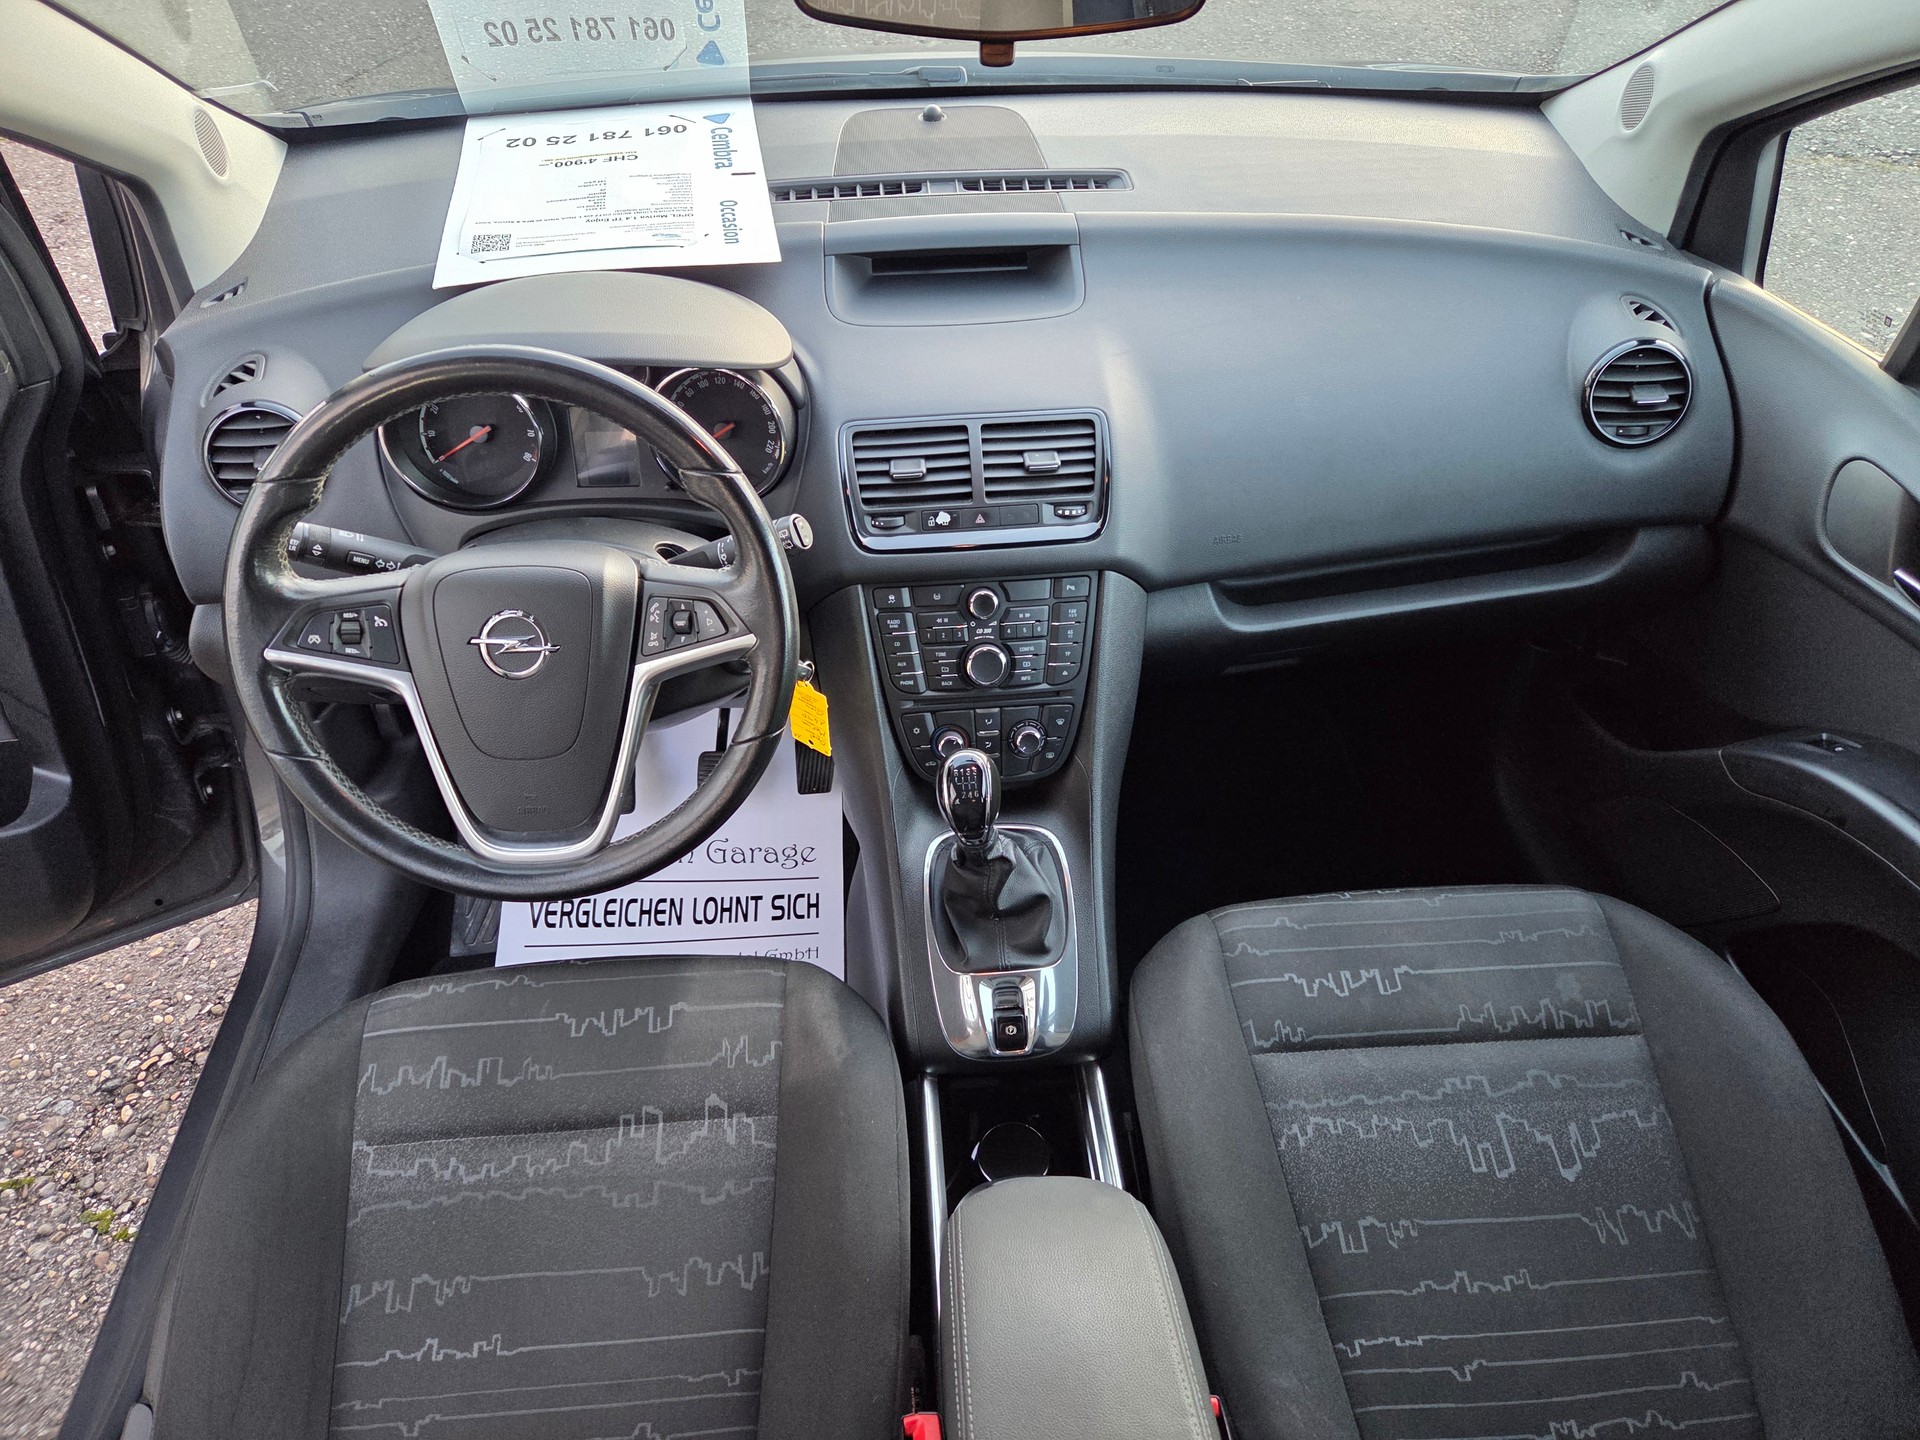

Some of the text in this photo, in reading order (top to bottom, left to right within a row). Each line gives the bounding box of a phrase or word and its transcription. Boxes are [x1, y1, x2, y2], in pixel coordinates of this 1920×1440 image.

[505, 124, 688, 148] 061 781 25 02
[710, 127, 738, 170] Cembra
[602, 154, 639, 163] CHF
[697, 379, 710, 389] 100
[714, 376, 726, 385] 120
[733, 379, 745, 390] 140
[767, 420, 777, 434] 200
[764, 440, 776, 454] 220
[352, 555, 371, 565] MENU
[706, 837, 818, 870] Garage
[529, 892, 820, 929] VERGLEICHEN LOHNT SICH
